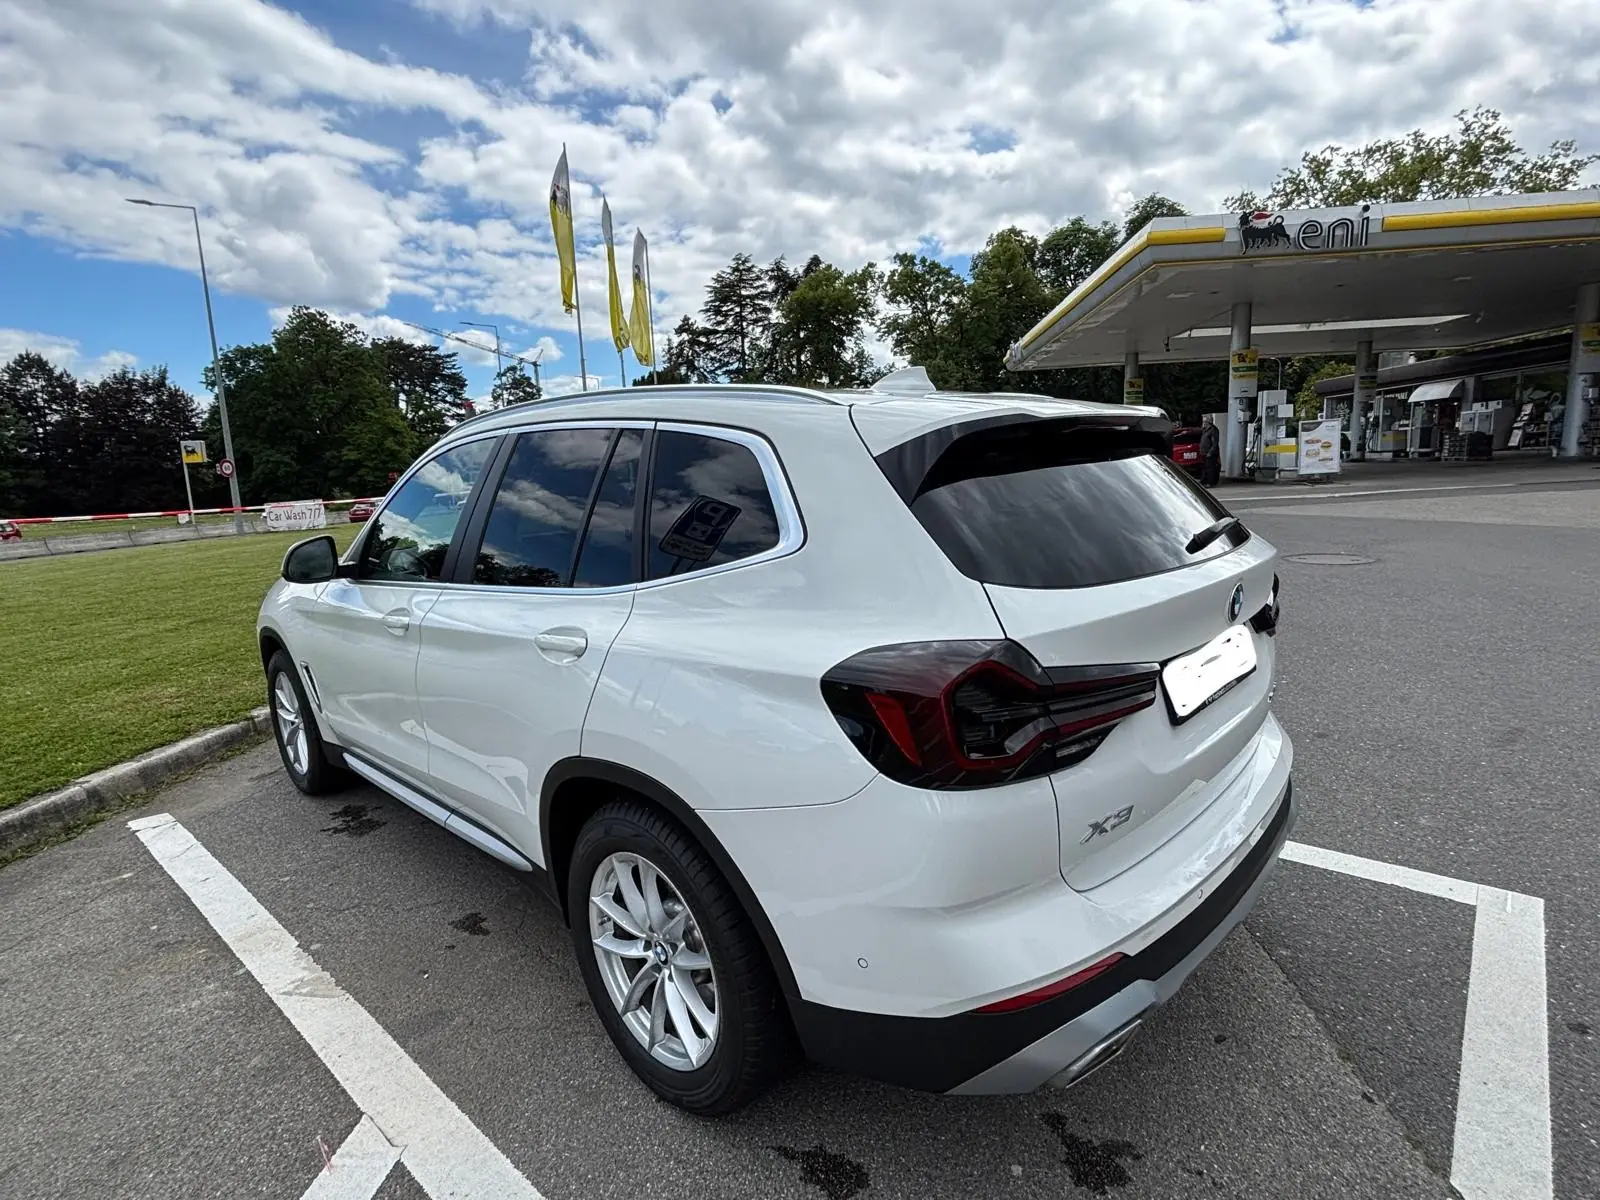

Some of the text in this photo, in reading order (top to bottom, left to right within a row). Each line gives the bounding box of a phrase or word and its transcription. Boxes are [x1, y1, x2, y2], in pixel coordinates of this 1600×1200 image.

[1297, 204, 1371, 250] eni
[268, 510, 282, 521] Car
[283, 509, 307, 520] Wash
